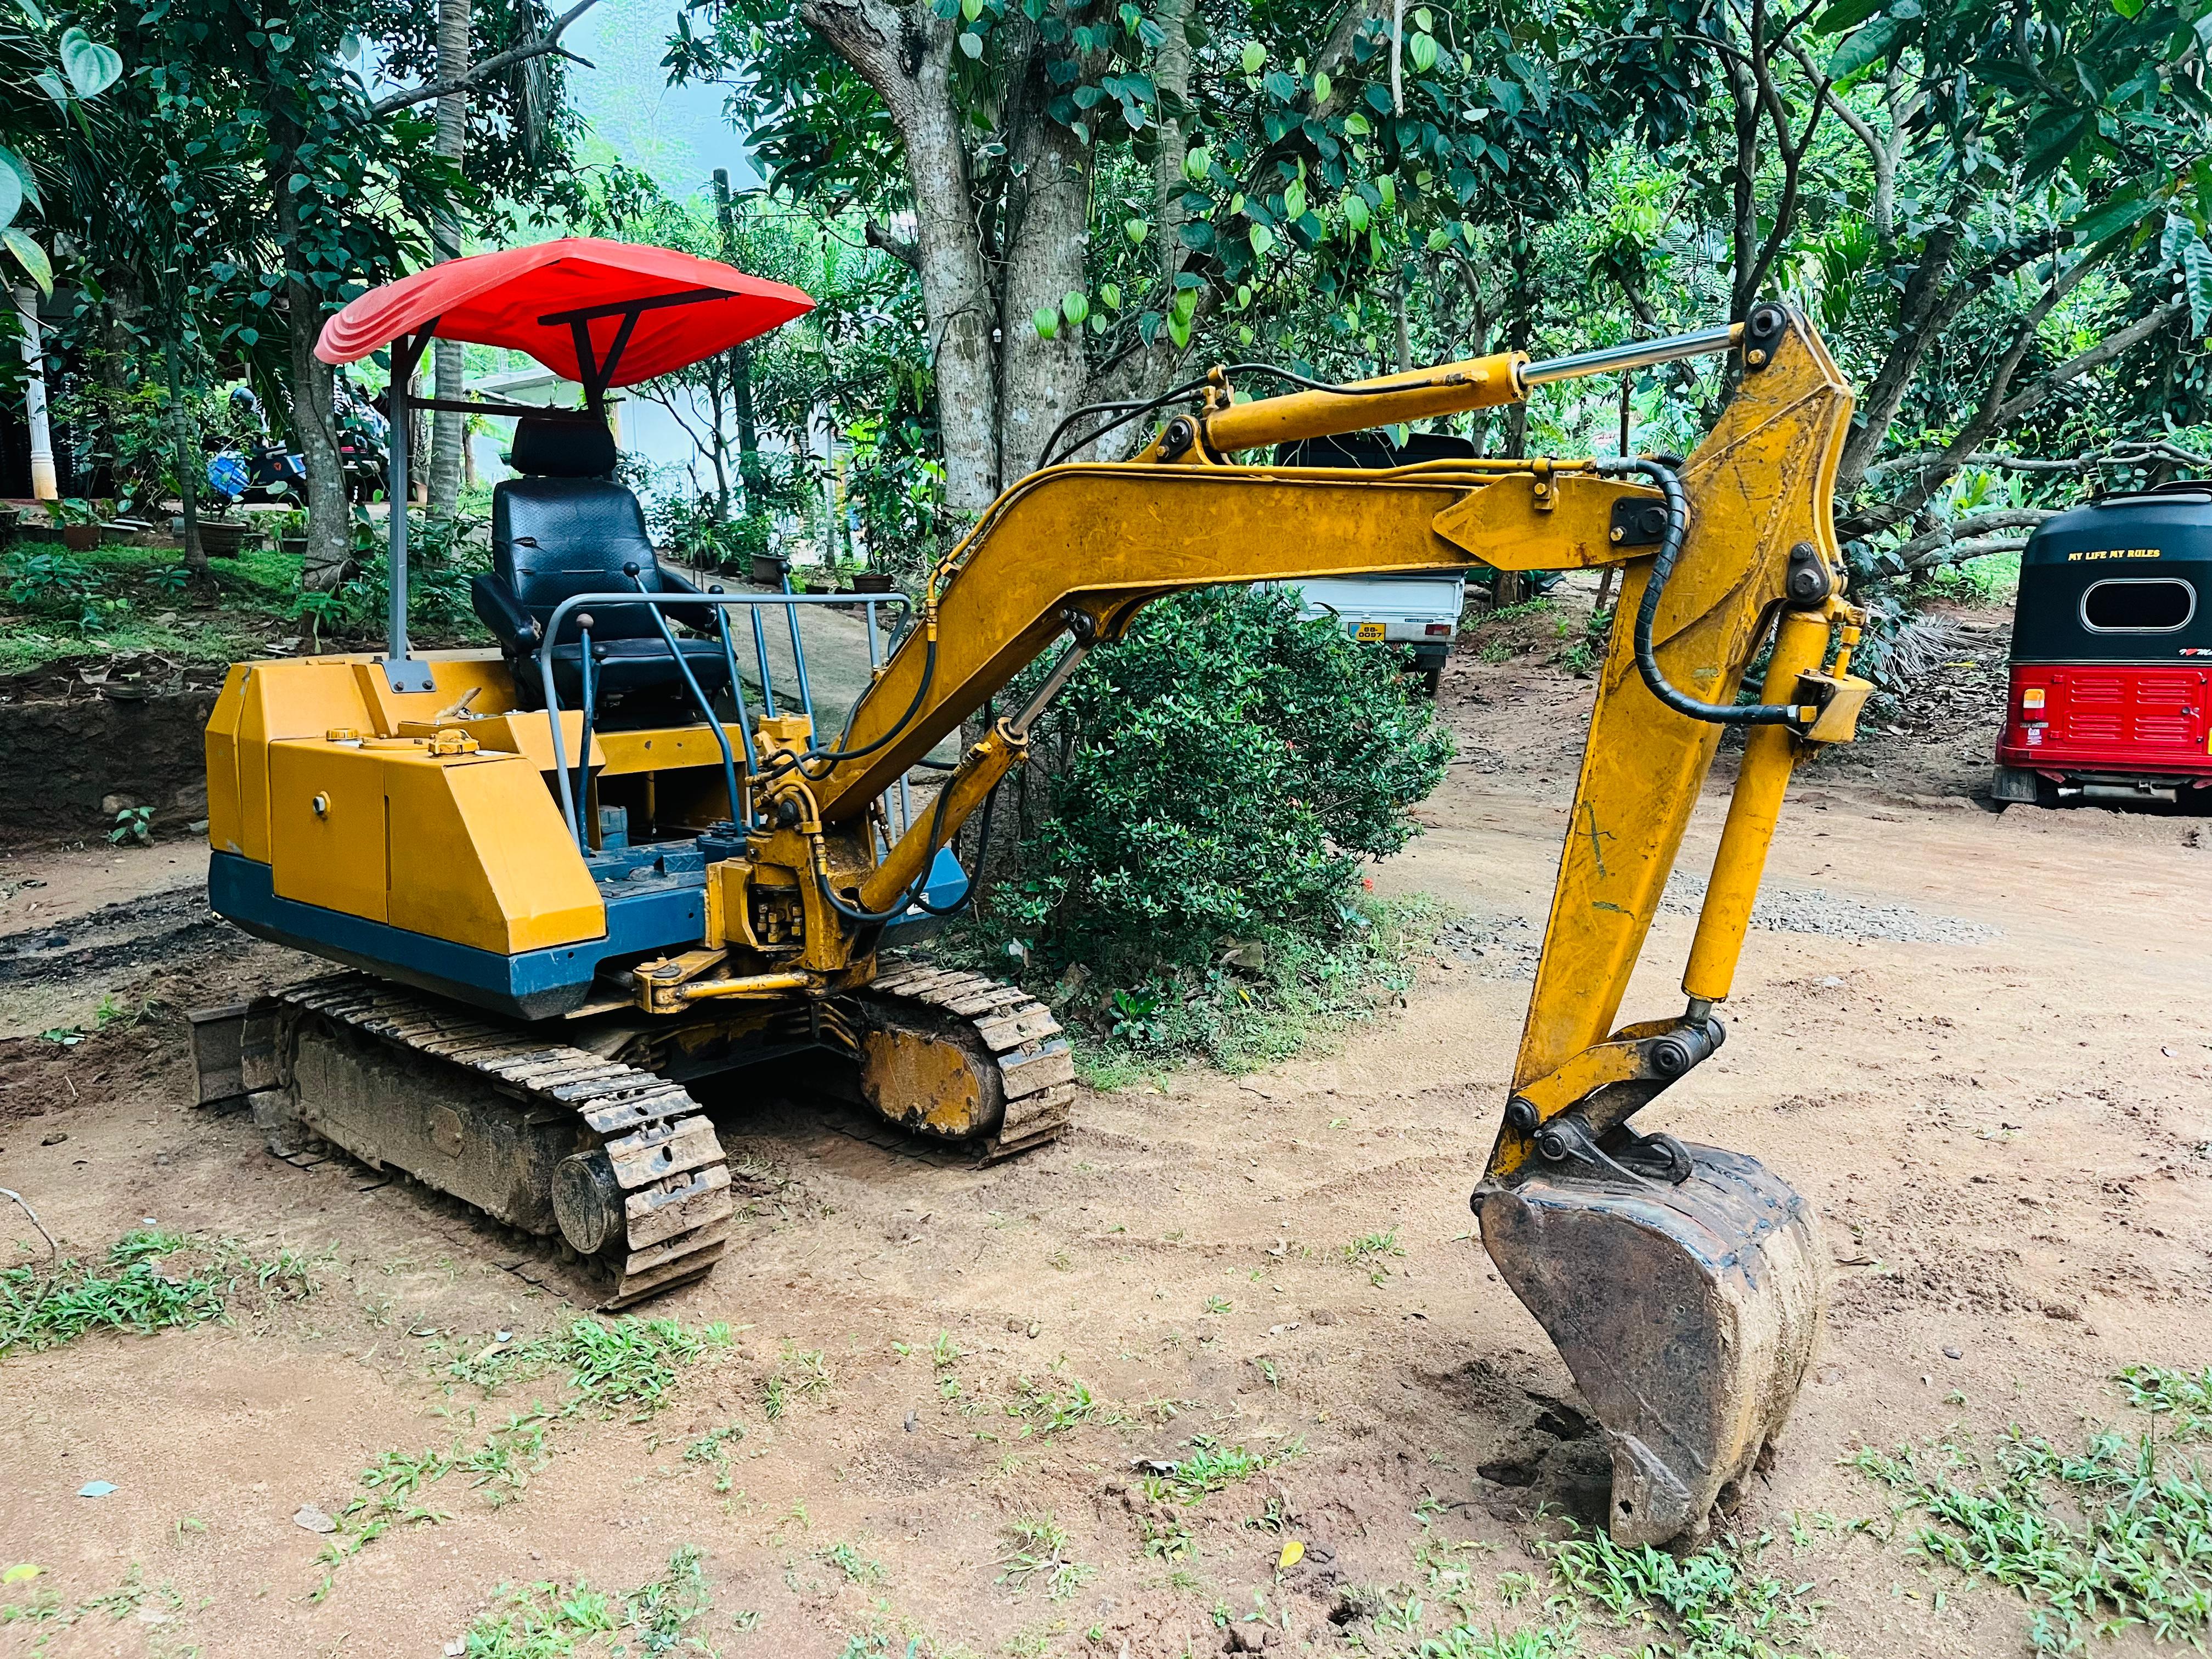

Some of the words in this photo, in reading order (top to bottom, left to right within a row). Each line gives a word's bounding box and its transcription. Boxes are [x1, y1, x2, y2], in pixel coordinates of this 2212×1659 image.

[2068, 552, 2083, 561] MY
[2085, 551, 2107, 560] LIFE
[2109, 550, 2125, 558] MY
[2127, 549, 2160, 557] RULES
